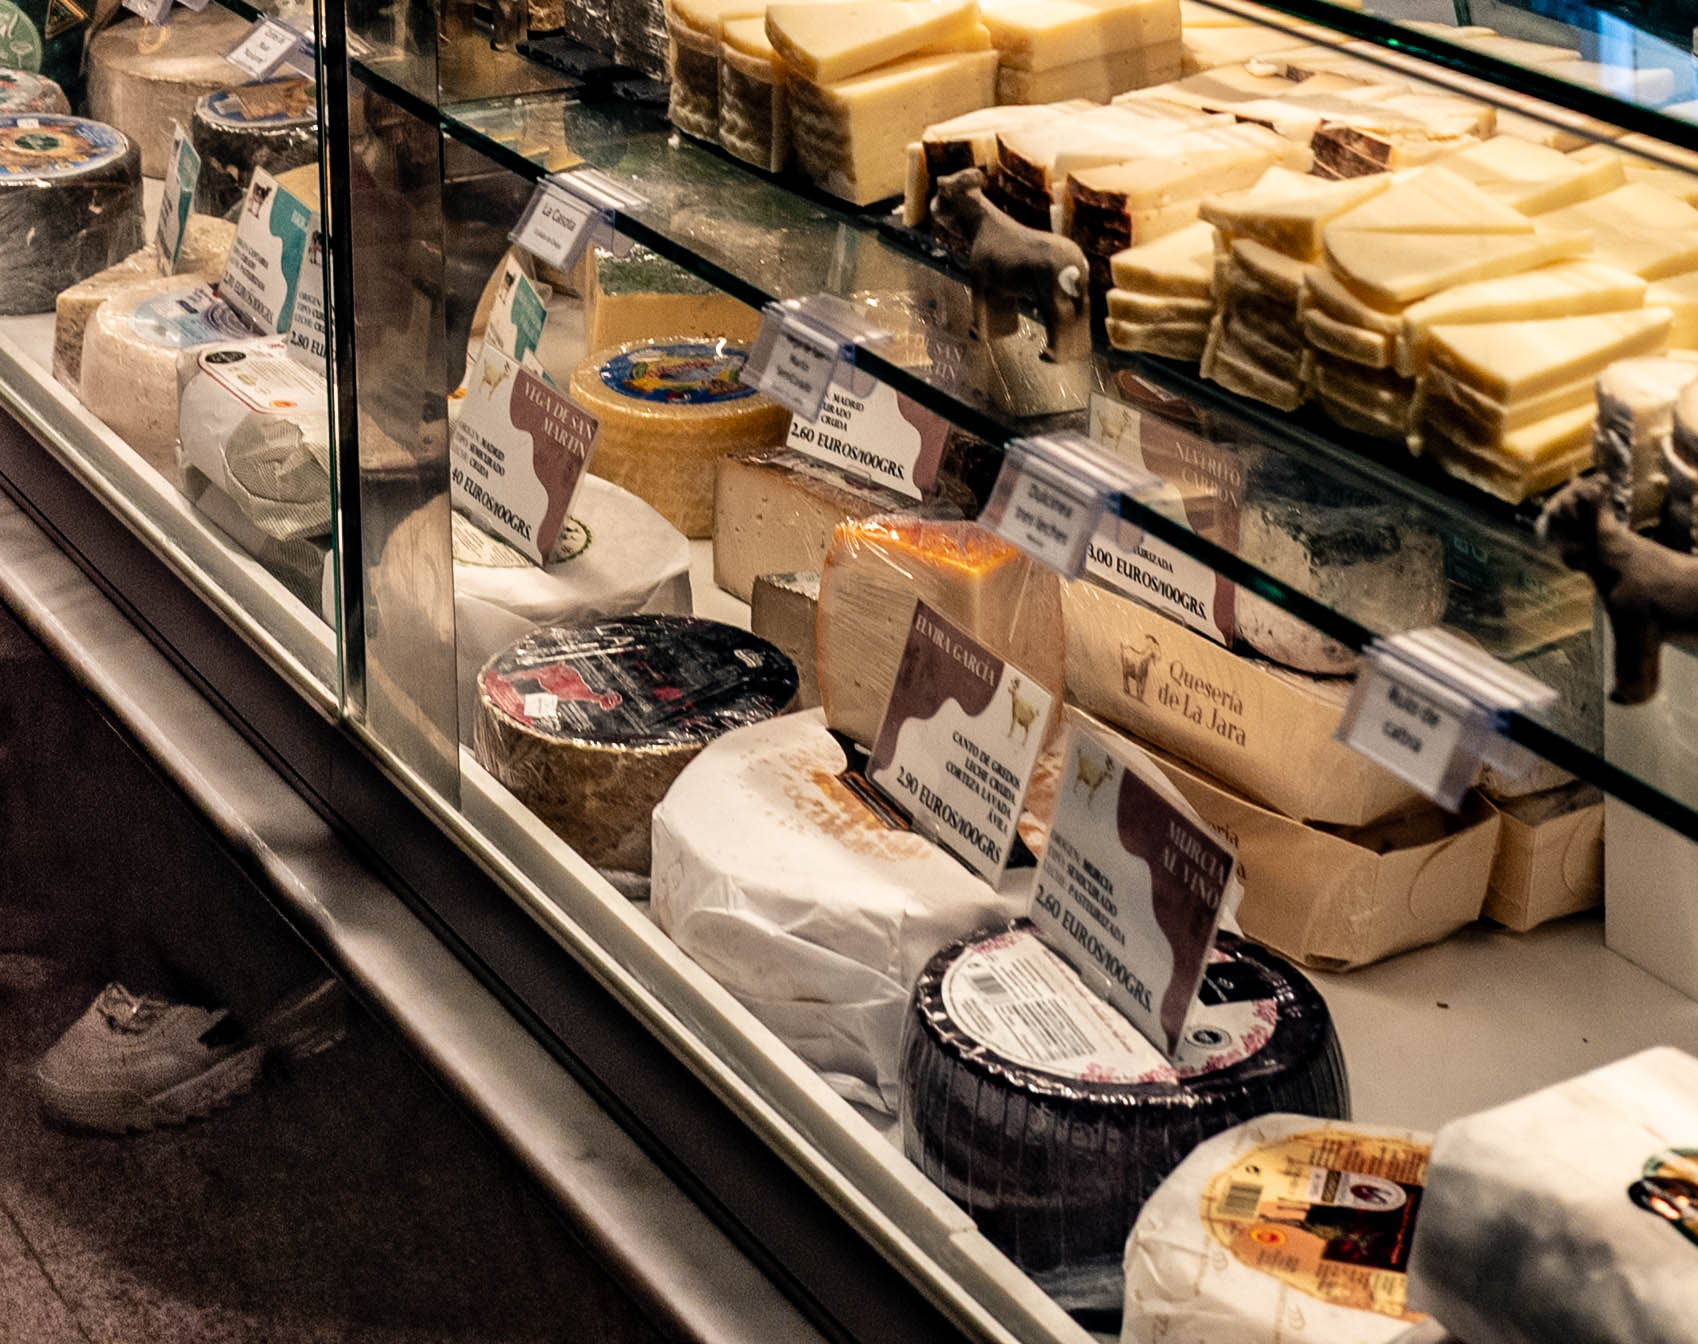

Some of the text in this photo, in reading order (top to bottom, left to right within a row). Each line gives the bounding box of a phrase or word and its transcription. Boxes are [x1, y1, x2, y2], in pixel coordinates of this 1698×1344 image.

[524, 381, 594, 441] VEGA DE SAN
[833, 393, 865, 413] MADRID
[542, 417, 586, 460] MARTIN
[791, 422, 815, 443] 2,60
[1087, 542, 1113, 568] 3,00
[915, 613, 996, 689] ELVIRA GARCÍA
[1169, 660, 1243, 717] Quesería
[1158, 682, 1247, 747] de La Jara
[952, 730, 979, 759] CANTO
[979, 747, 992, 768] DE
[945, 760, 1013, 821] CORTEZA LAVADA
[964, 756, 1017, 807] LECHE CRUDA
[1169, 820, 1226, 887] MURCIA
[1184, 863, 1220, 910] VINO
